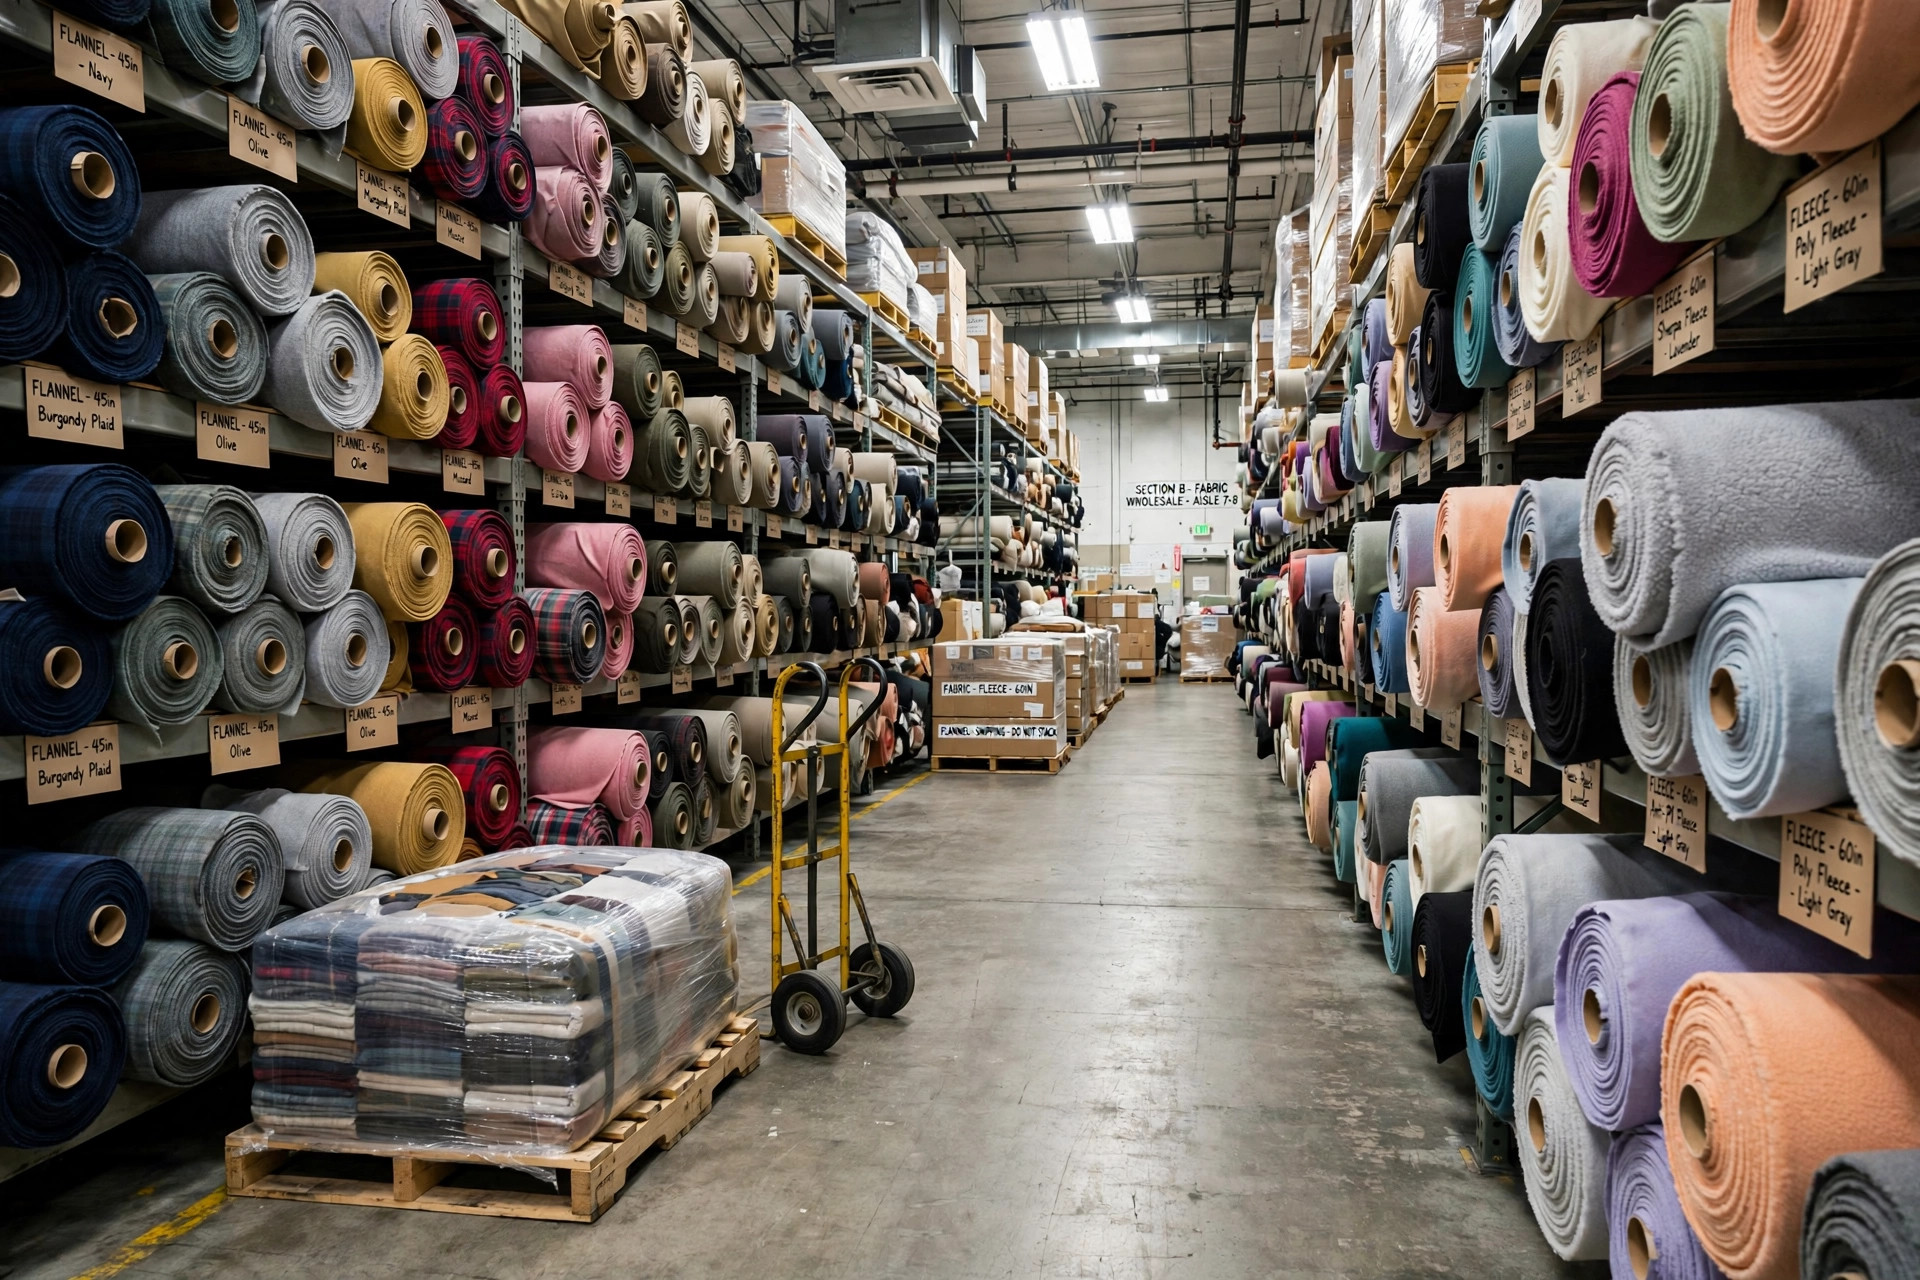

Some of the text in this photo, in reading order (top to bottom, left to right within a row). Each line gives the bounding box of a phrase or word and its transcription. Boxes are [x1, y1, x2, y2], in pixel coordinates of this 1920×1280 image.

[60, 22, 109, 60] FLANNEL
[117, 51, 138, 73] 45in
[88, 60, 113, 91] Navy
[233, 109, 270, 139] FLANNEL
[248, 137, 269, 159] Olive
[1790, 188, 1831, 232] FLEECE
[1842, 173, 1869, 203] 60in
[1795, 230, 1816, 260] Poly
[1821, 216, 1857, 245] Fleece
[1803, 256, 1829, 288] Light
[1834, 246, 1862, 271] Gray
[1656, 284, 1682, 315] FLEECE
[1684, 305, 1708, 327] Fleece
[32, 379, 84, 403] FLANNEL
[93, 391, 115, 408] 45in
[91, 413, 115, 431] Plaid
[201, 410, 241, 432] FLANNEL
[248, 420, 266, 435] 45in
[215, 434, 237, 452] Olive
[336, 434, 366, 452] FLANNEL
[1135, 483, 1175, 495] SECTION
[1179, 483, 1186, 494] B
[1195, 482, 1228, 494] FABRIC
[1193, 495, 1219, 506] AISLE
[1223, 495, 1239, 506] 7-8
[943, 683, 971, 694] FABRIC
[978, 683, 1007, 694] FLEECE
[349, 706, 377, 722] FLANNEL
[213, 722, 251, 740] FLANNEL
[1011, 727, 1021, 736] DO
[32, 740, 82, 762] FLANNEL
[92, 737, 113, 754] 45in
[230, 743, 252, 758] Olive
[89, 759, 112, 778] Plaid
[1649, 775, 1675, 800] FLEECE
[1786, 820, 1826, 854] FLEECE
[1838, 837, 1863, 867] 60in
[1793, 853, 1813, 887] Poly
[1817, 862, 1851, 896] Fleece
[1798, 885, 1822, 918] Light
[1827, 897, 1853, 937] Gray
